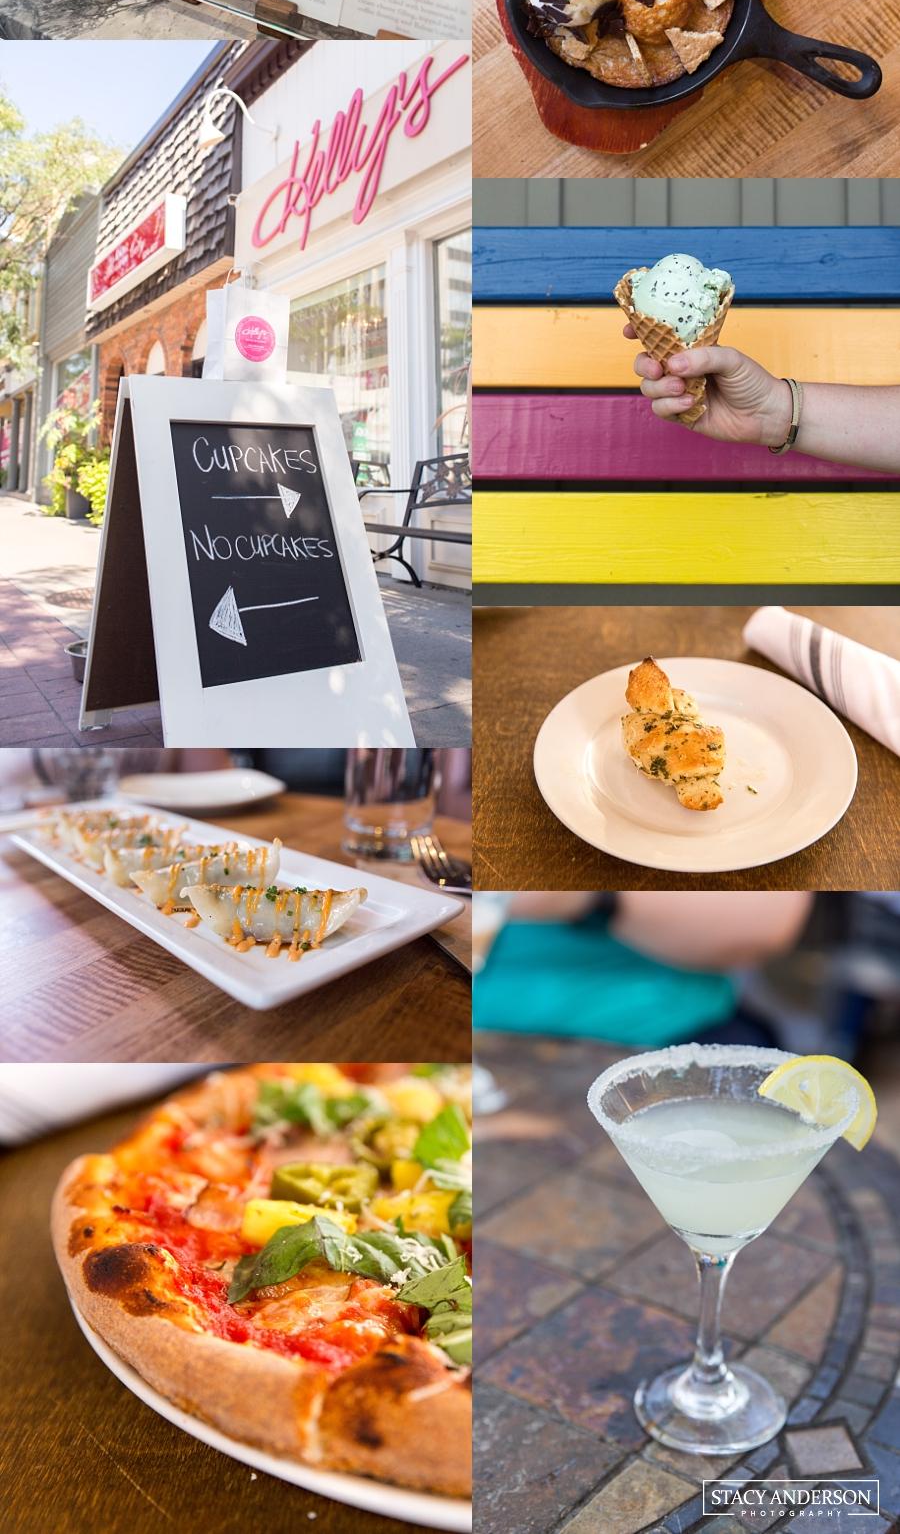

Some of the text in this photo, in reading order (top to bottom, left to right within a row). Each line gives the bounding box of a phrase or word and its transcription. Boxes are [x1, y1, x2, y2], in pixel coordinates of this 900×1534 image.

[251, 53, 470, 251] Kelly's
[192, 436, 317, 474] CUPCAKES
[189, 524, 334, 561] NO CUPCAKES
